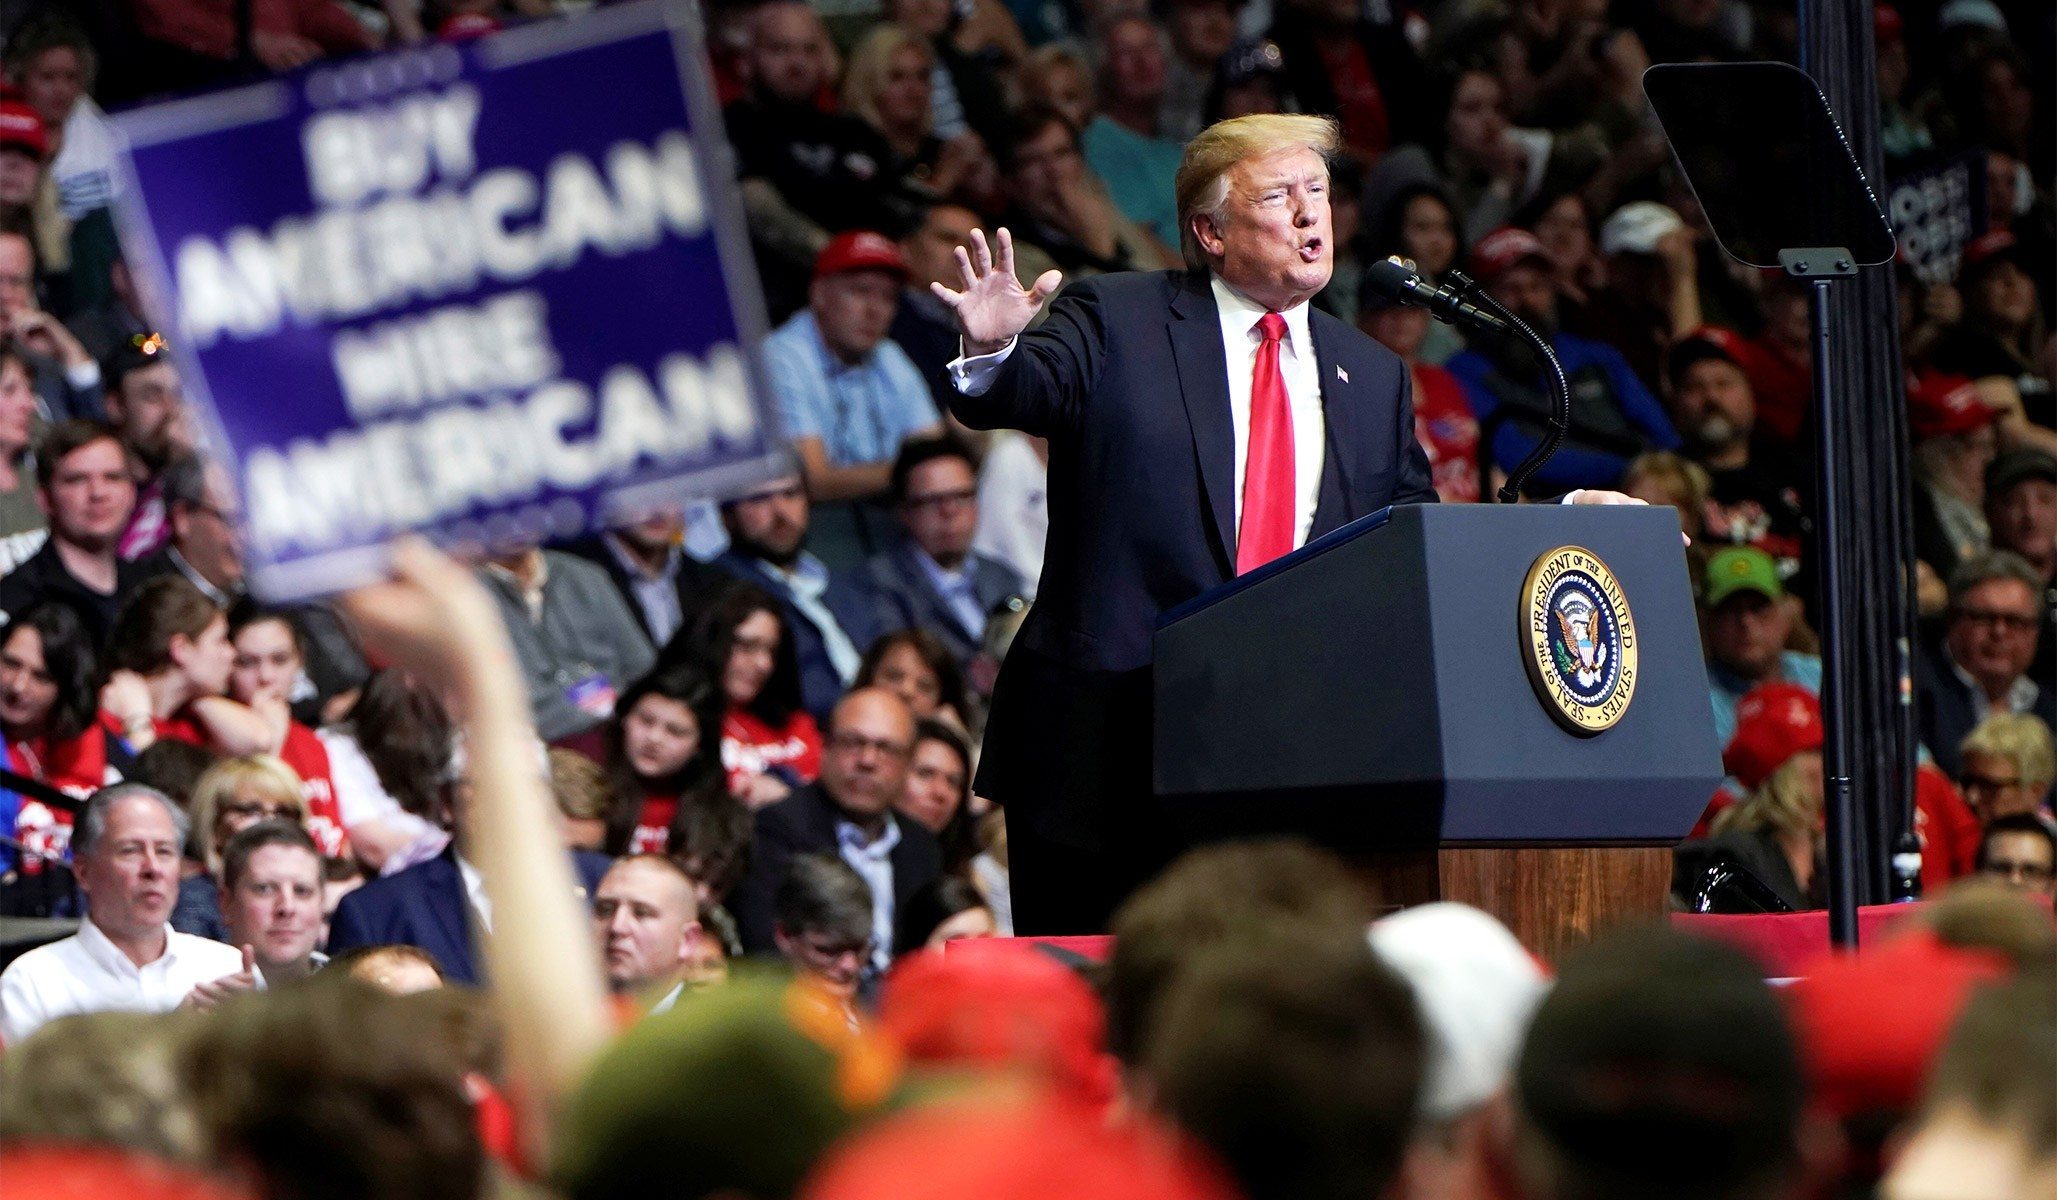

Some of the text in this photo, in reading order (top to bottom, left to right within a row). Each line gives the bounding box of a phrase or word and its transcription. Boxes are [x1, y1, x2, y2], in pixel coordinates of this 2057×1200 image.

[308, 88, 478, 206] BUY
[177, 132, 704, 344] AMERICAN
[333, 293, 557, 420] HIRE
[247, 342, 758, 556] AMERICAN
[1534, 552, 1633, 722] SEAL OF THE PRESIDENT OF THE UNITED STATES
